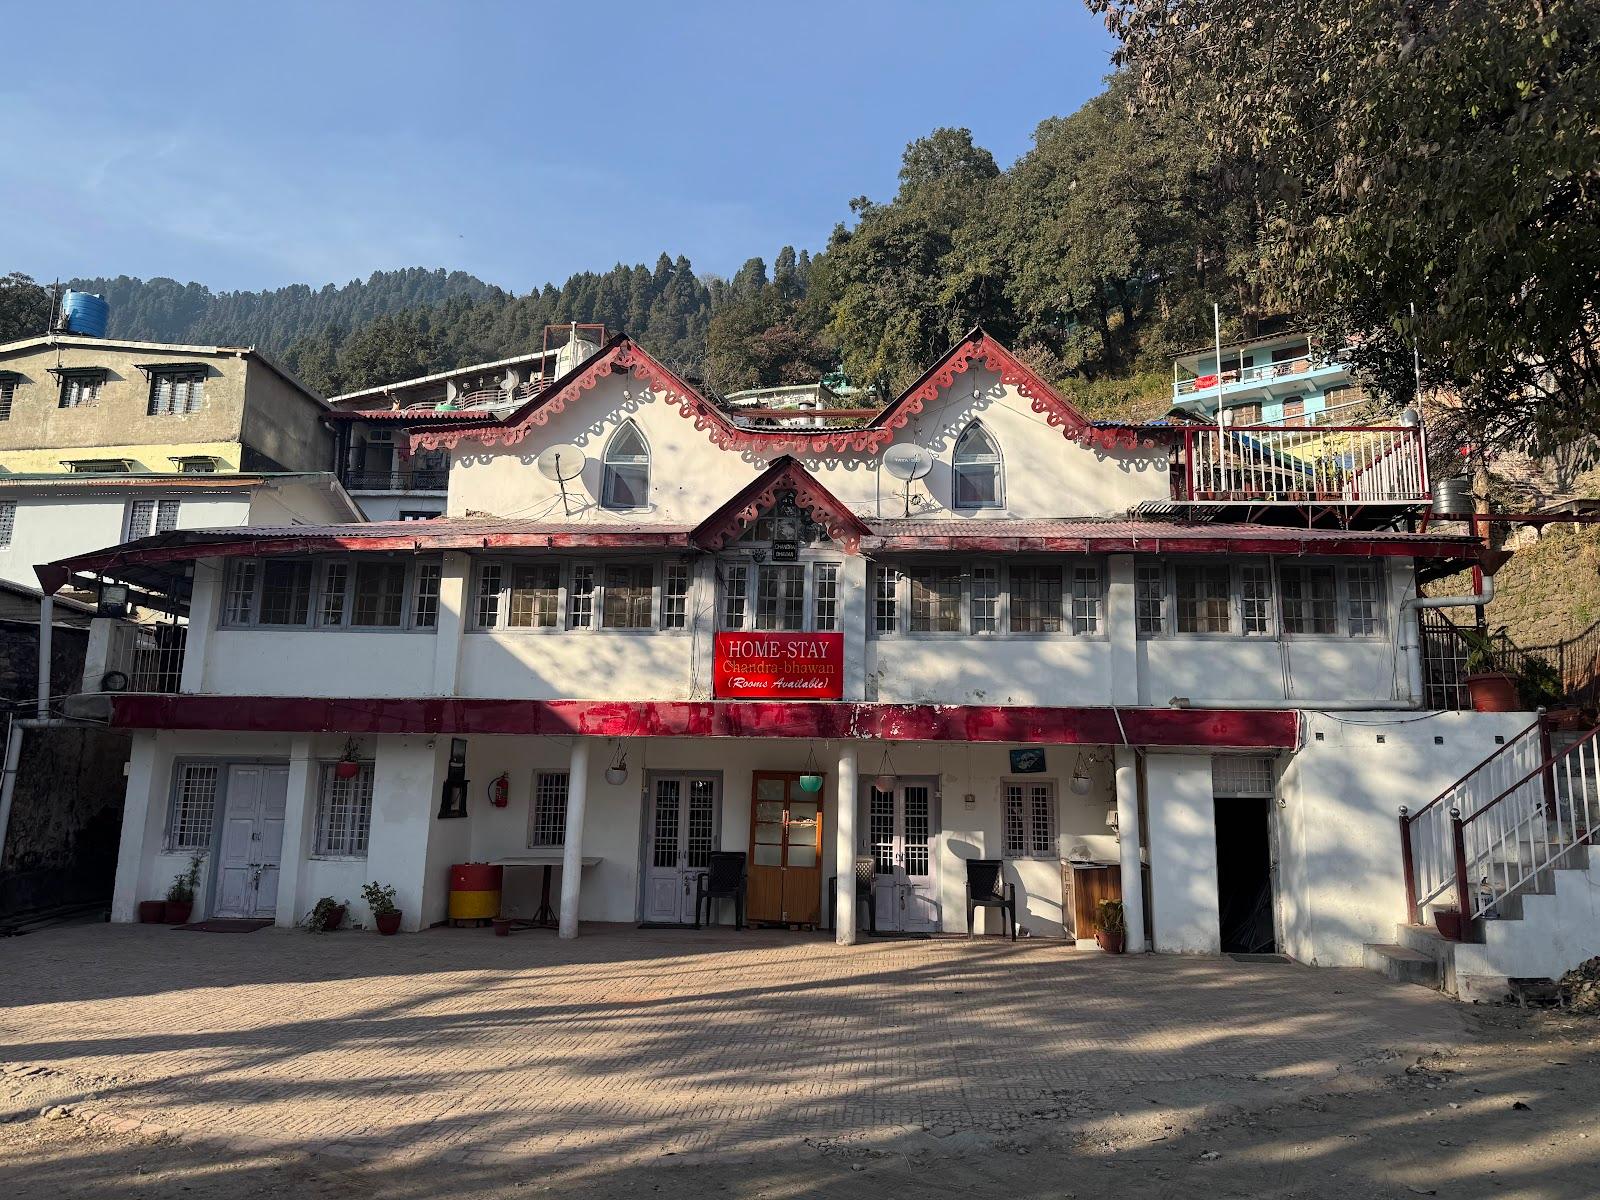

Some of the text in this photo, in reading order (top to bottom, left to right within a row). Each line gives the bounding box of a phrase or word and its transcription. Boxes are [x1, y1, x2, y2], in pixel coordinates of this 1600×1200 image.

[728, 640, 830, 659] HOME-STAY
[722, 659, 835, 674] Chandra-bhawan
[727, 676, 829, 689] (Rooms Available)
